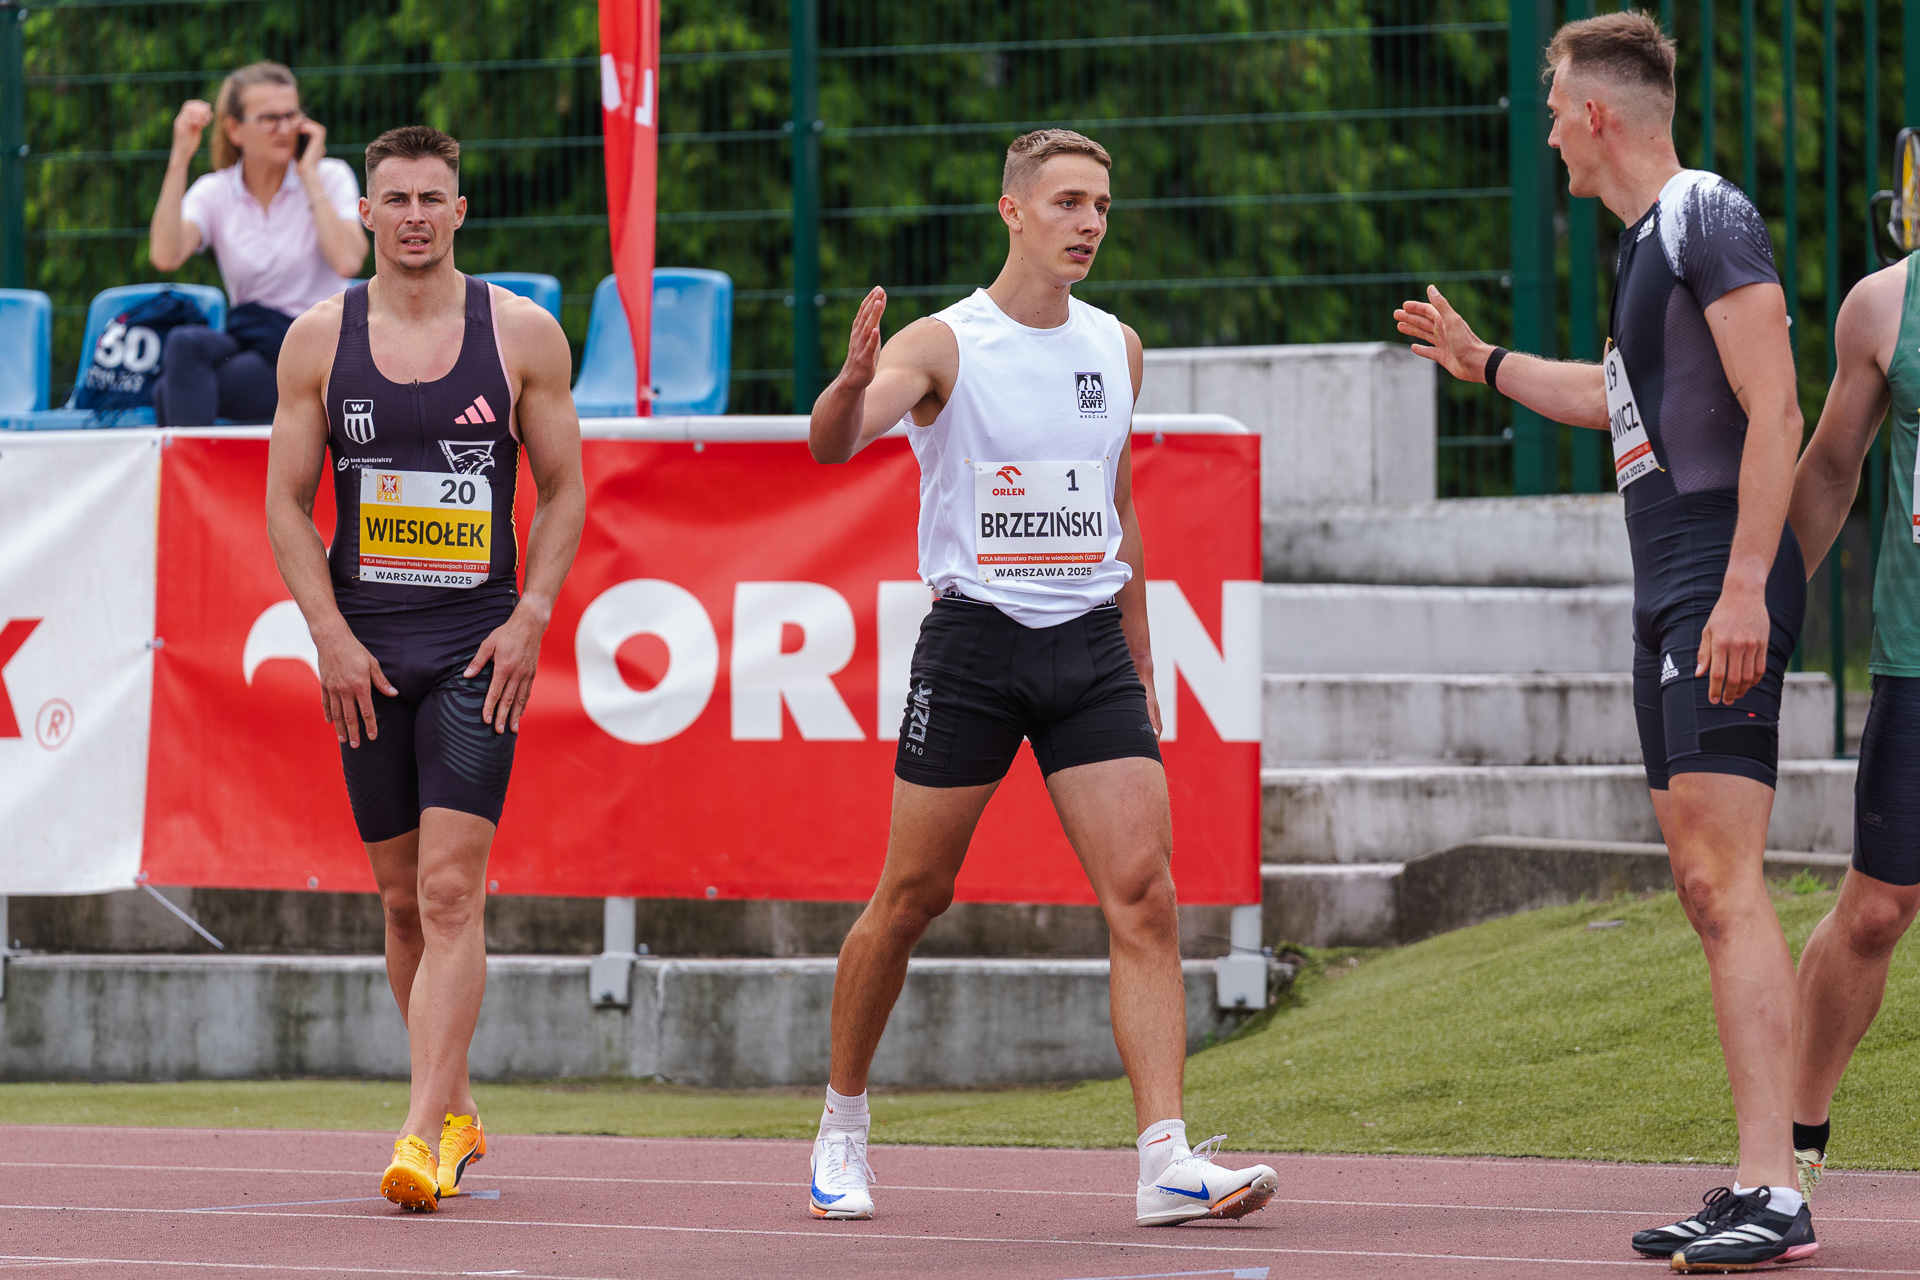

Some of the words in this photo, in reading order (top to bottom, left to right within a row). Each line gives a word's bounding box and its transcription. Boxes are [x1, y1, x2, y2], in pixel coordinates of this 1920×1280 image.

[1606, 360, 1618, 391] 19
[1080, 390, 1102, 399] AZS
[1080, 400, 1103, 408] AWF
[1629, 461, 1646, 478] 2025
[1066, 469, 1079, 491] 1
[440, 479, 476, 505] 20
[992, 488, 1025, 496] ORLEN
[981, 506, 1103, 538] BRZEZIŃSKI
[365, 516, 485, 548] WIESIOŁEK
[375, 559, 406, 567] Mistrzostwa
[428, 562, 463, 570] wielobojach
[994, 568, 1065, 577] WARSZAWA
[1067, 567, 1092, 576] 2025
[375, 570, 442, 584] WARSZAWA
[443, 575, 473, 585] 2025
[575, 579, 1262, 743] ORN
[907, 680, 933, 743] DZIK
[905, 742, 924, 756] PRO
